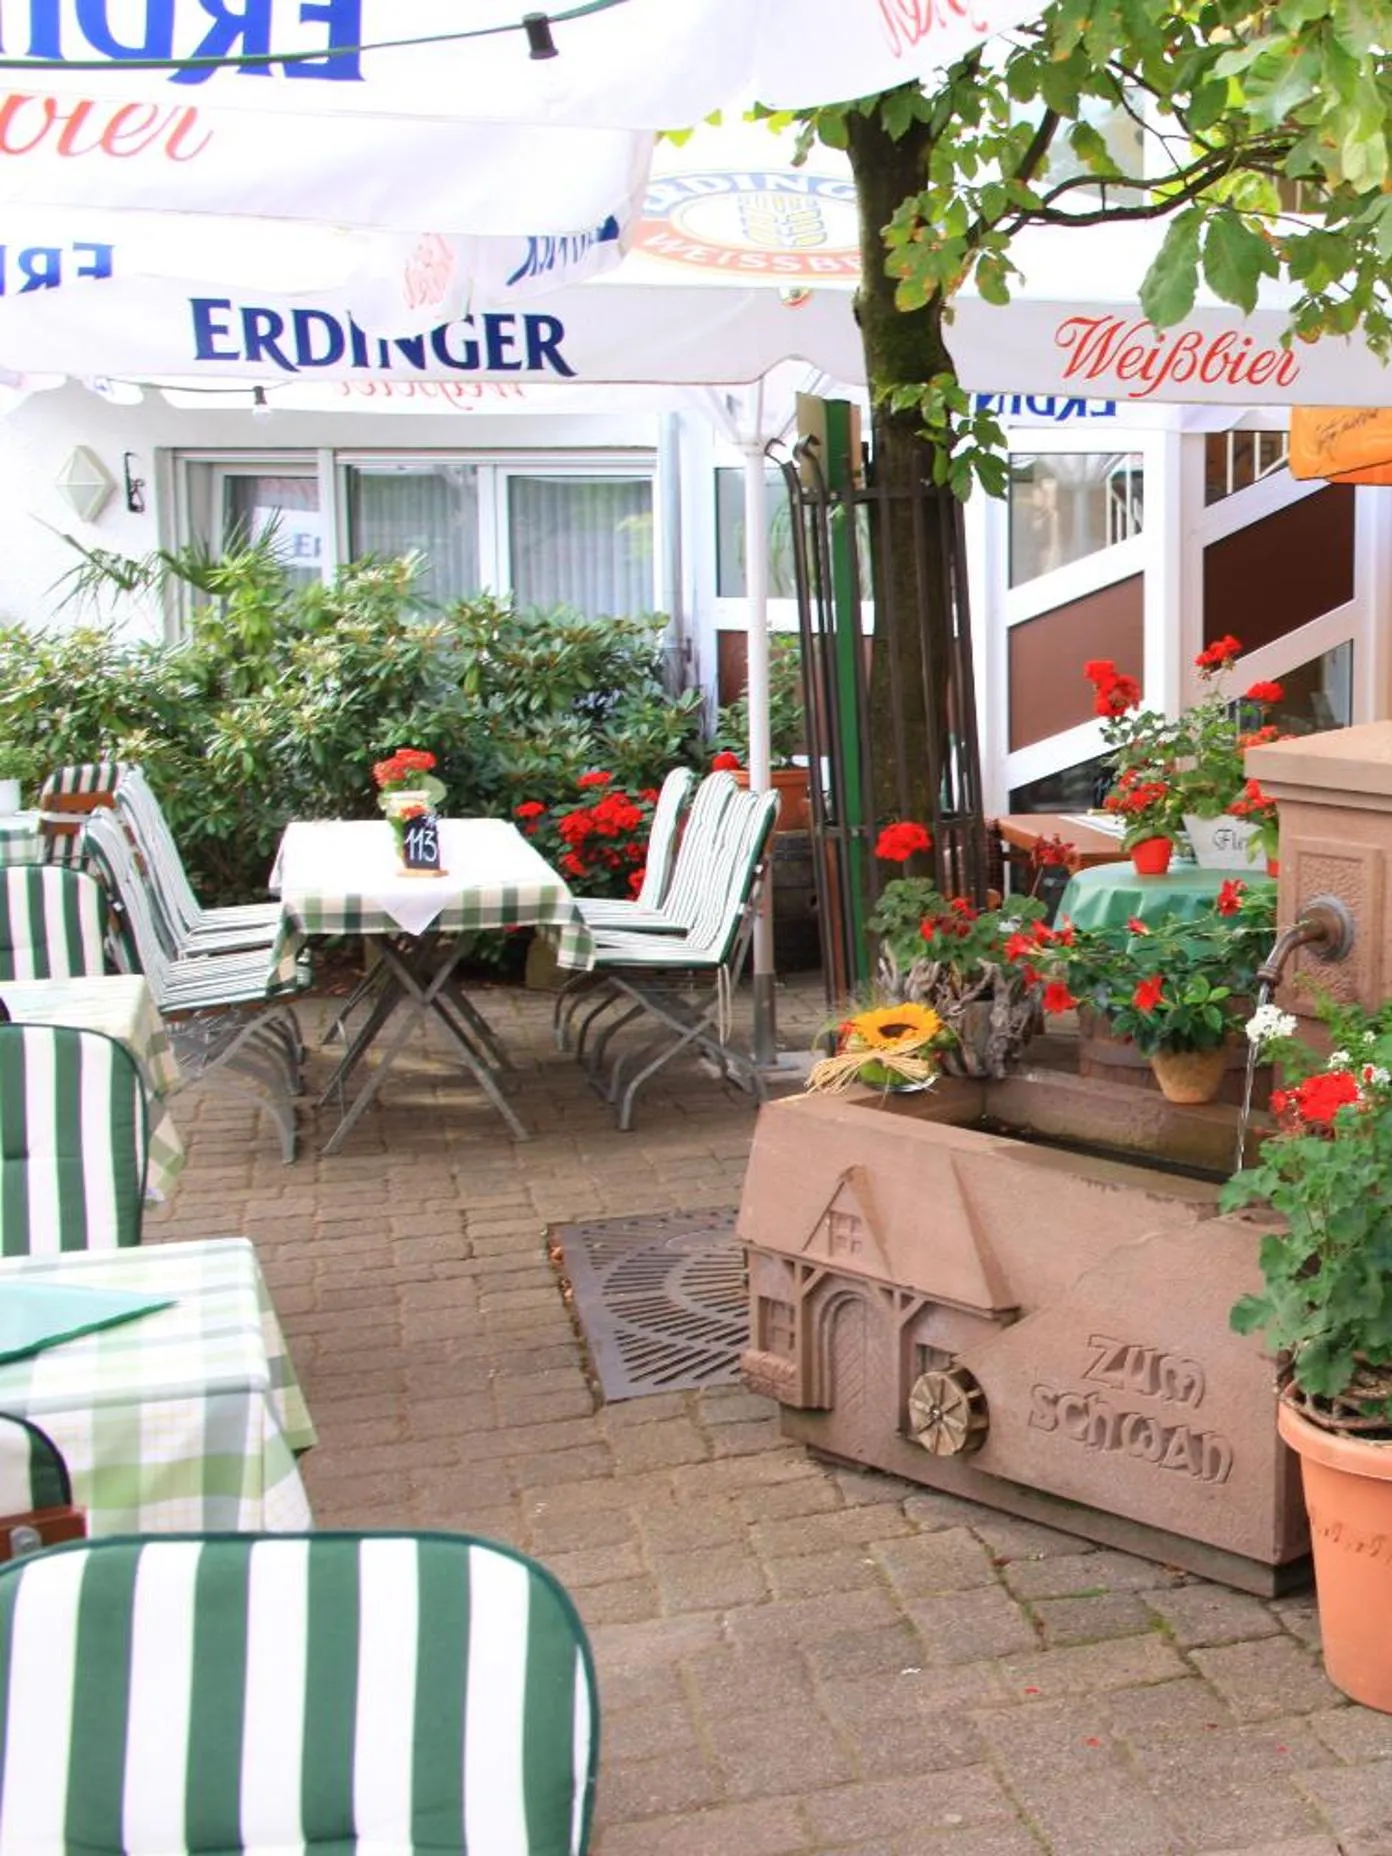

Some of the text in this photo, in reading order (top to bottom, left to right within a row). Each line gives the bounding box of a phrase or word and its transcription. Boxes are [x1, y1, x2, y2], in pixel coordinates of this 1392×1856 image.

[189, 298, 578, 378] ERDINGER
[1055, 315, 1299, 397] Weißbier
[404, 827, 437, 862] 113
